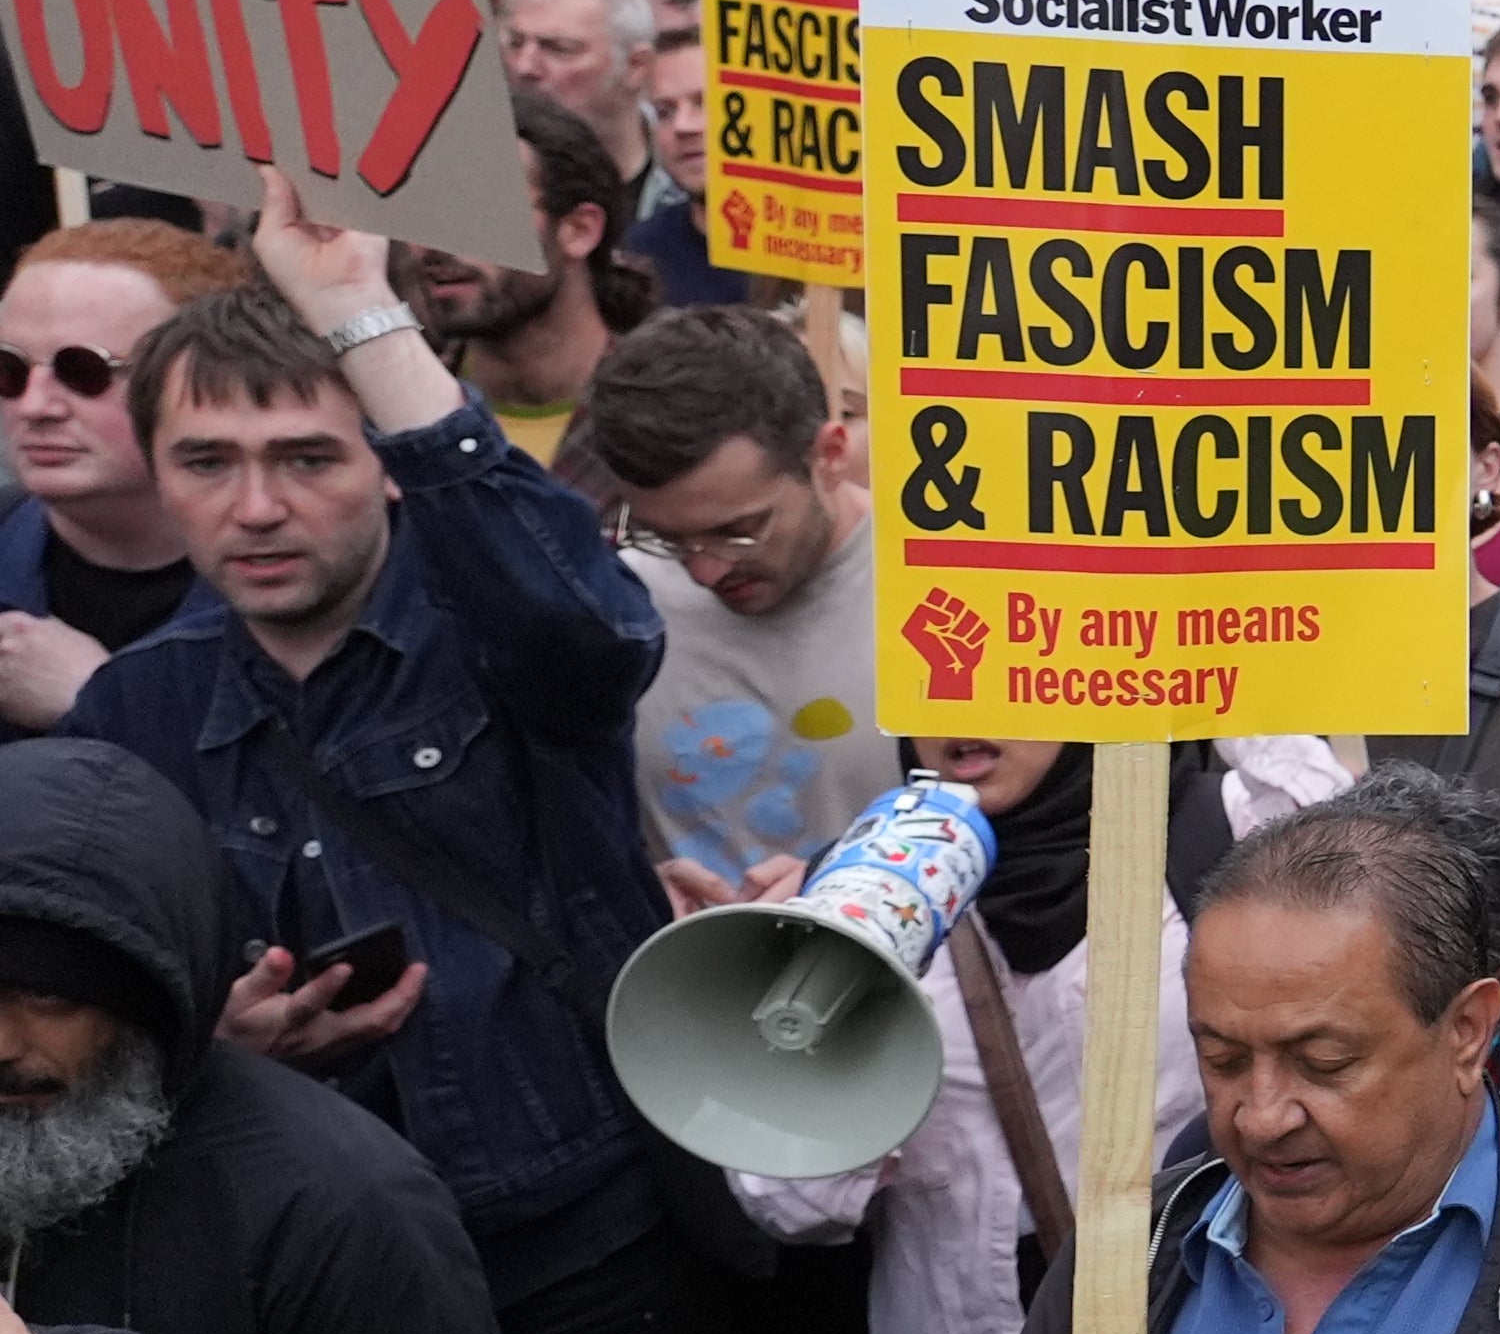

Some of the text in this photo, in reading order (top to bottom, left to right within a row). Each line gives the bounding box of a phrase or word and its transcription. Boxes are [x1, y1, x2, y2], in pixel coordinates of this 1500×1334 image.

[896, 56, 1285, 200] SMASH
[900, 233, 1372, 371] FASCISM
[900, 405, 1436, 539] & RACISM
[1008, 591, 1322, 659] By any means
[1008, 662, 1239, 715] necessary
